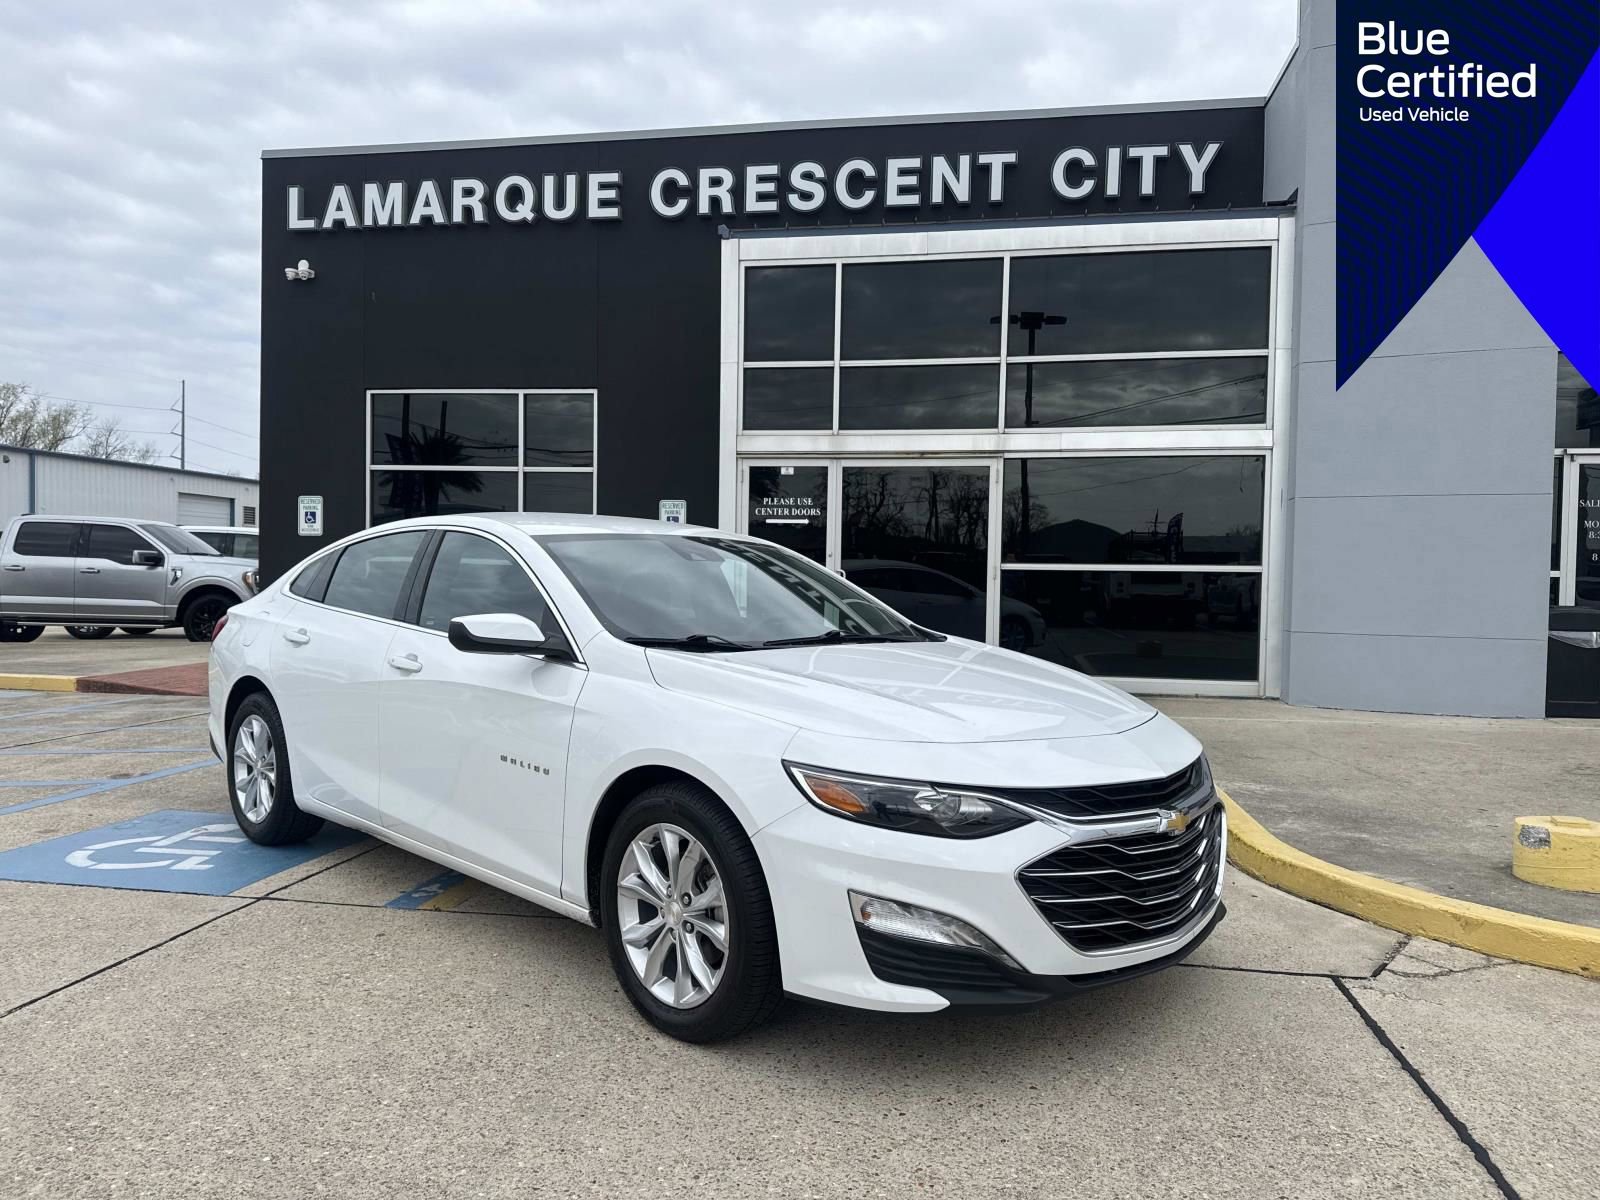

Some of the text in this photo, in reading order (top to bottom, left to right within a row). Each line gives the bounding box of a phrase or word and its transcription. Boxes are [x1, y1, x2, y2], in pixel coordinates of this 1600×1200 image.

[287, 142, 1222, 230] LAMARQUE CRESCENT CITY
[763, 497, 814, 506] PLEASE USE
[755, 507, 821, 516] CENTER DOORS
